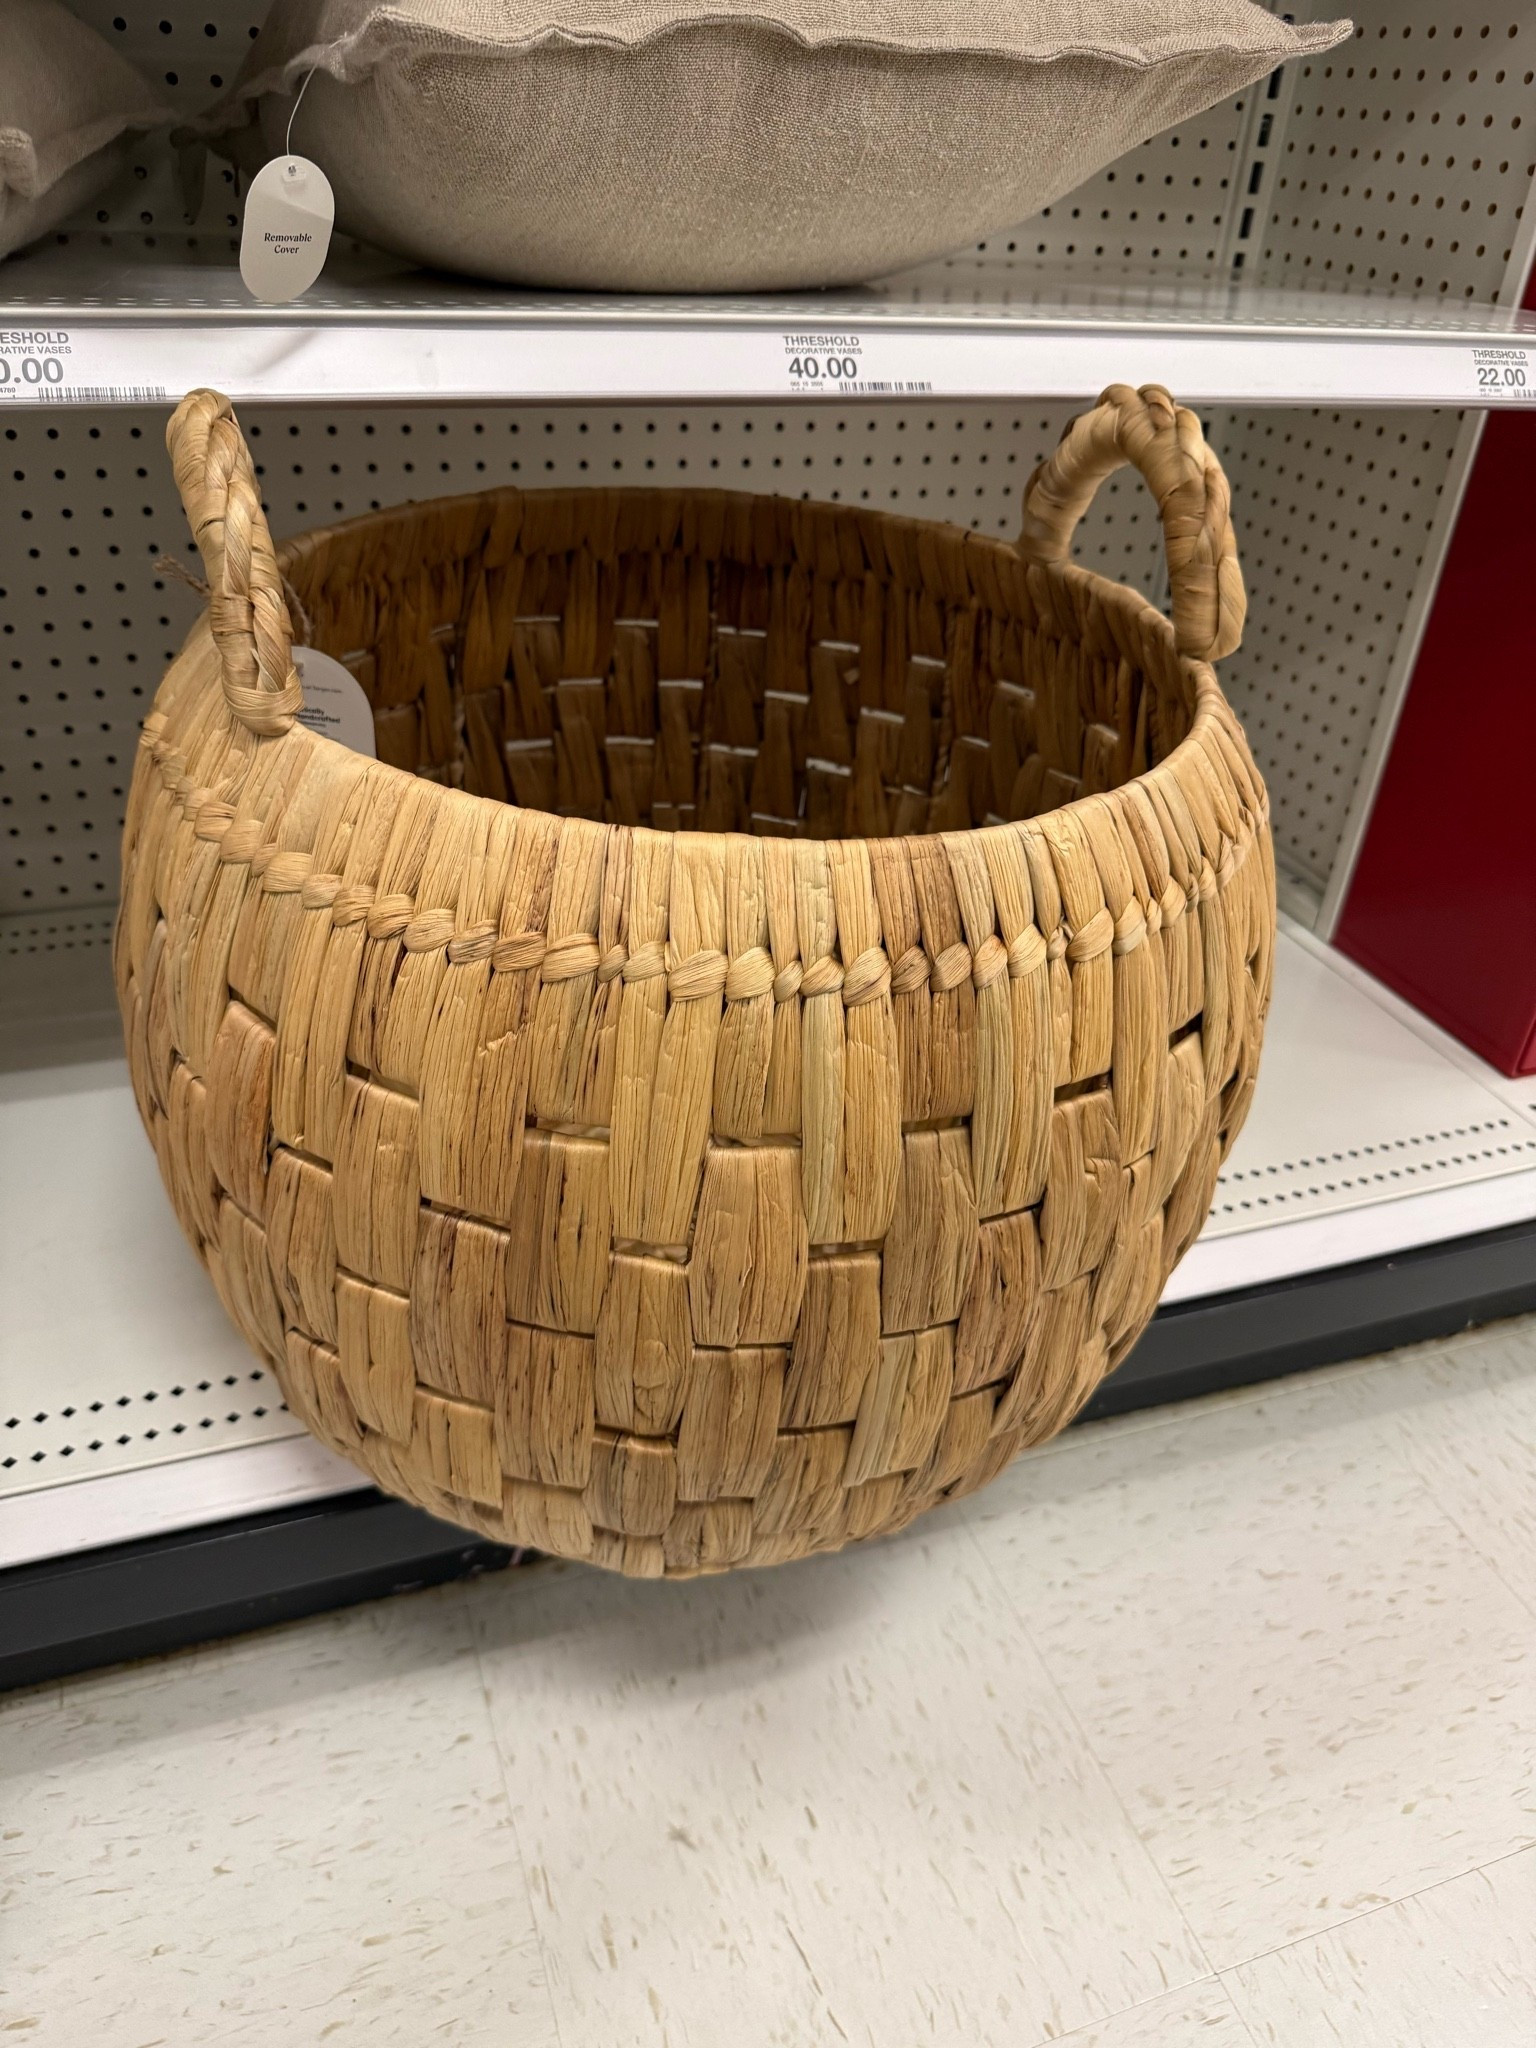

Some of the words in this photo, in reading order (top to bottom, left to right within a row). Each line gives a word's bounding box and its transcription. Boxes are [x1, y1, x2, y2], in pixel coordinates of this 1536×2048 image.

[264, 233, 312, 242] Removable
[274, 245, 299, 254] Cover
[783, 335, 859, 346] THRESHOLD
[37, 346, 72, 354] VASES
[837, 347, 862, 355] VASES
[1472, 350, 1526, 359] THRESHOLD
[789, 357, 857, 378] 40.00
[1477, 368, 1526, 386] 22.00
